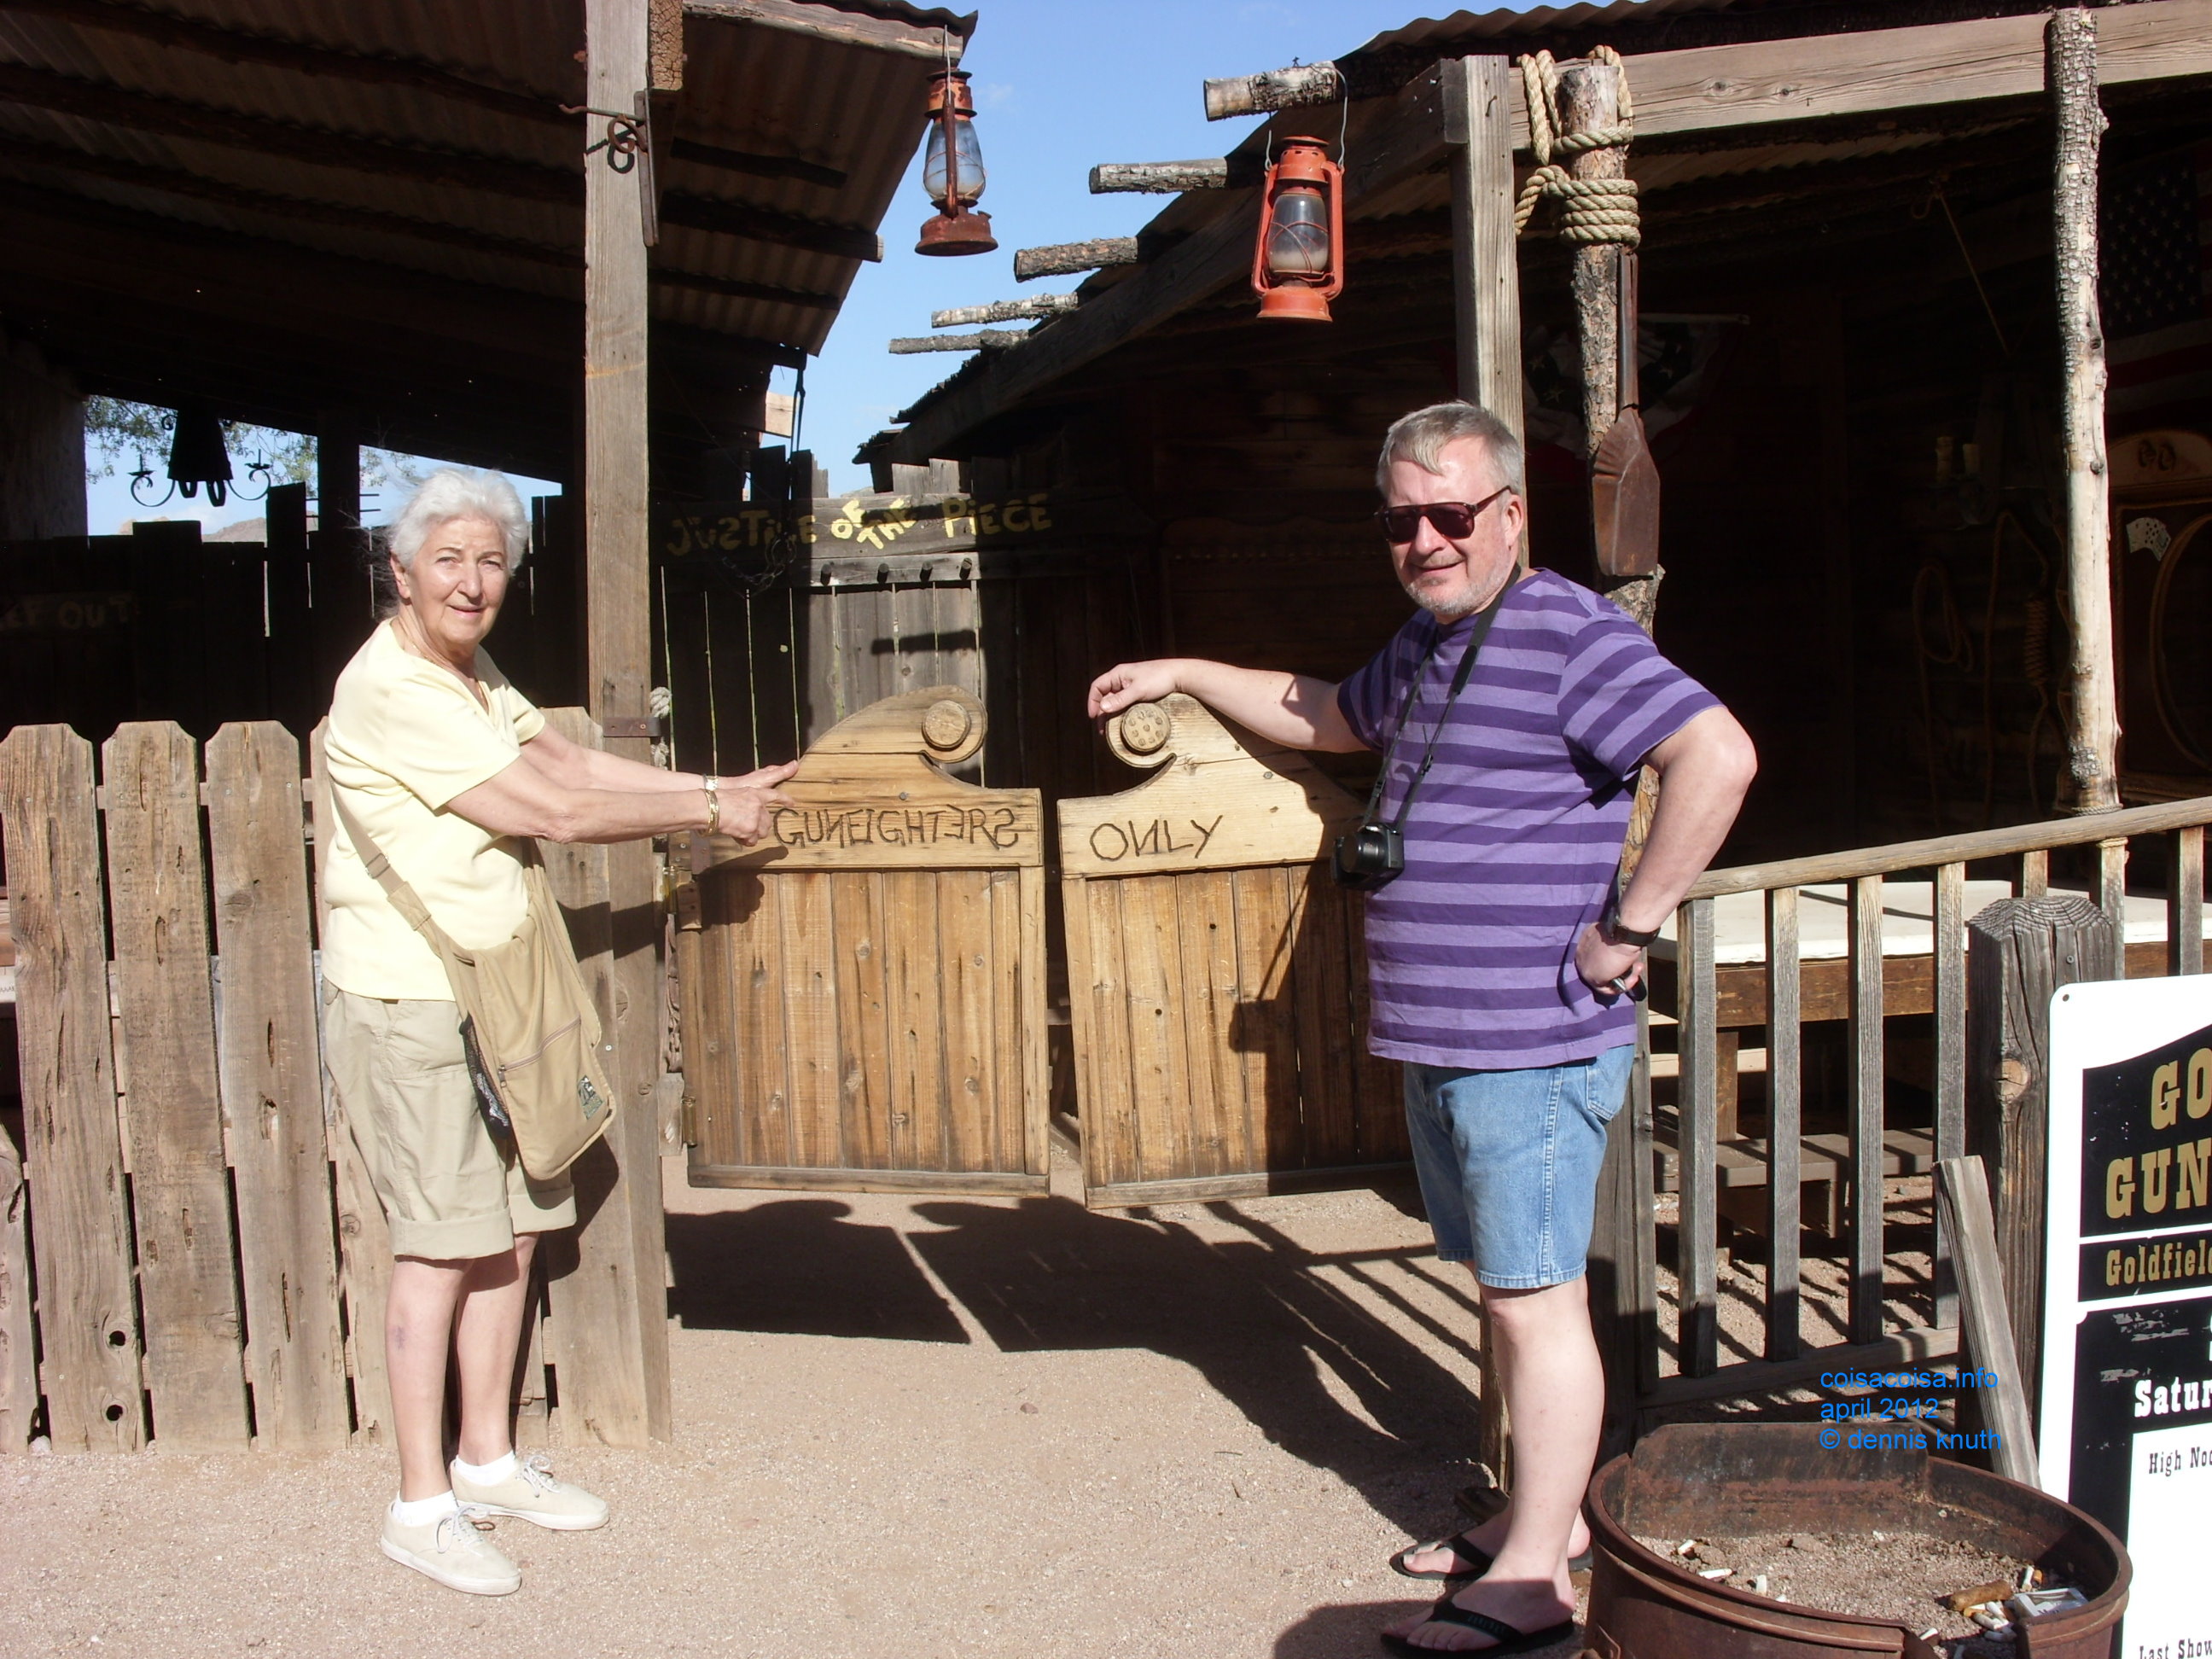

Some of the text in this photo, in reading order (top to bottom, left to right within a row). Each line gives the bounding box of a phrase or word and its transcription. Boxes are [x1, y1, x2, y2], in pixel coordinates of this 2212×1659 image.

[1090, 815, 1223, 861] ONLY
[2105, 1138, 2212, 1219] GUN
[2149, 1450, 2181, 1477] High
